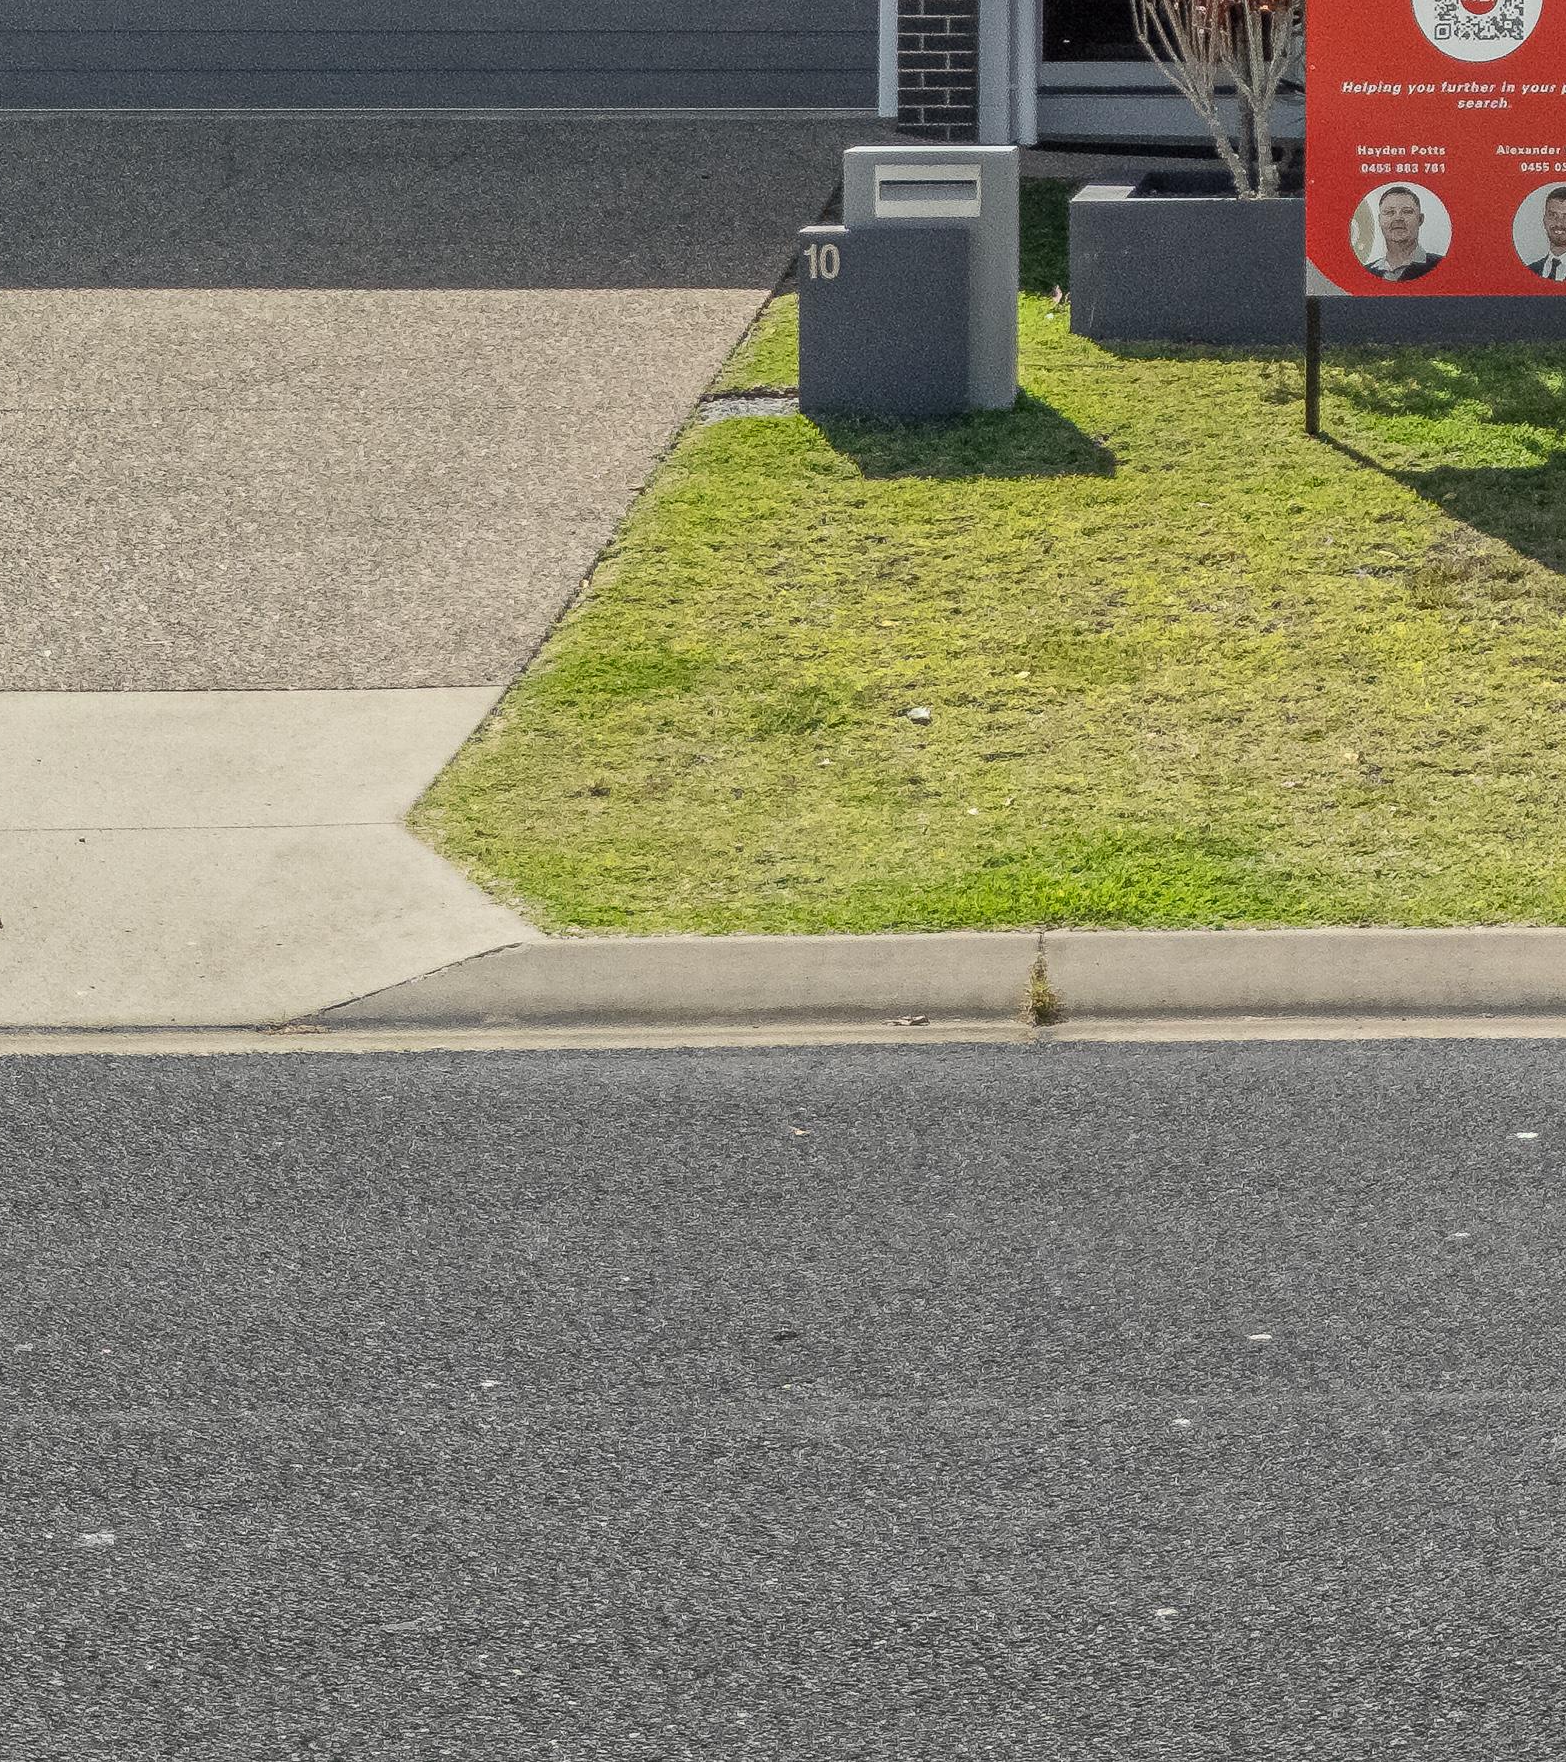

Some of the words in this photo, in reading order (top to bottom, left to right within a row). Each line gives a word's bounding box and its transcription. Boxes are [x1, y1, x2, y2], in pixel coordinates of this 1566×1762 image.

[1342, 81, 1401, 95] Helping
[1407, 85, 1435, 96] you
[1441, 81, 1496, 93] further
[1501, 81, 1516, 93] in
[1521, 83, 1556, 95] your
[1357, 145, 1406, 157] Hayden
[1411, 145, 1446, 155] Potts
[1496, 145, 1561, 155] Alexander
[804, 243, 841, 280] 10
